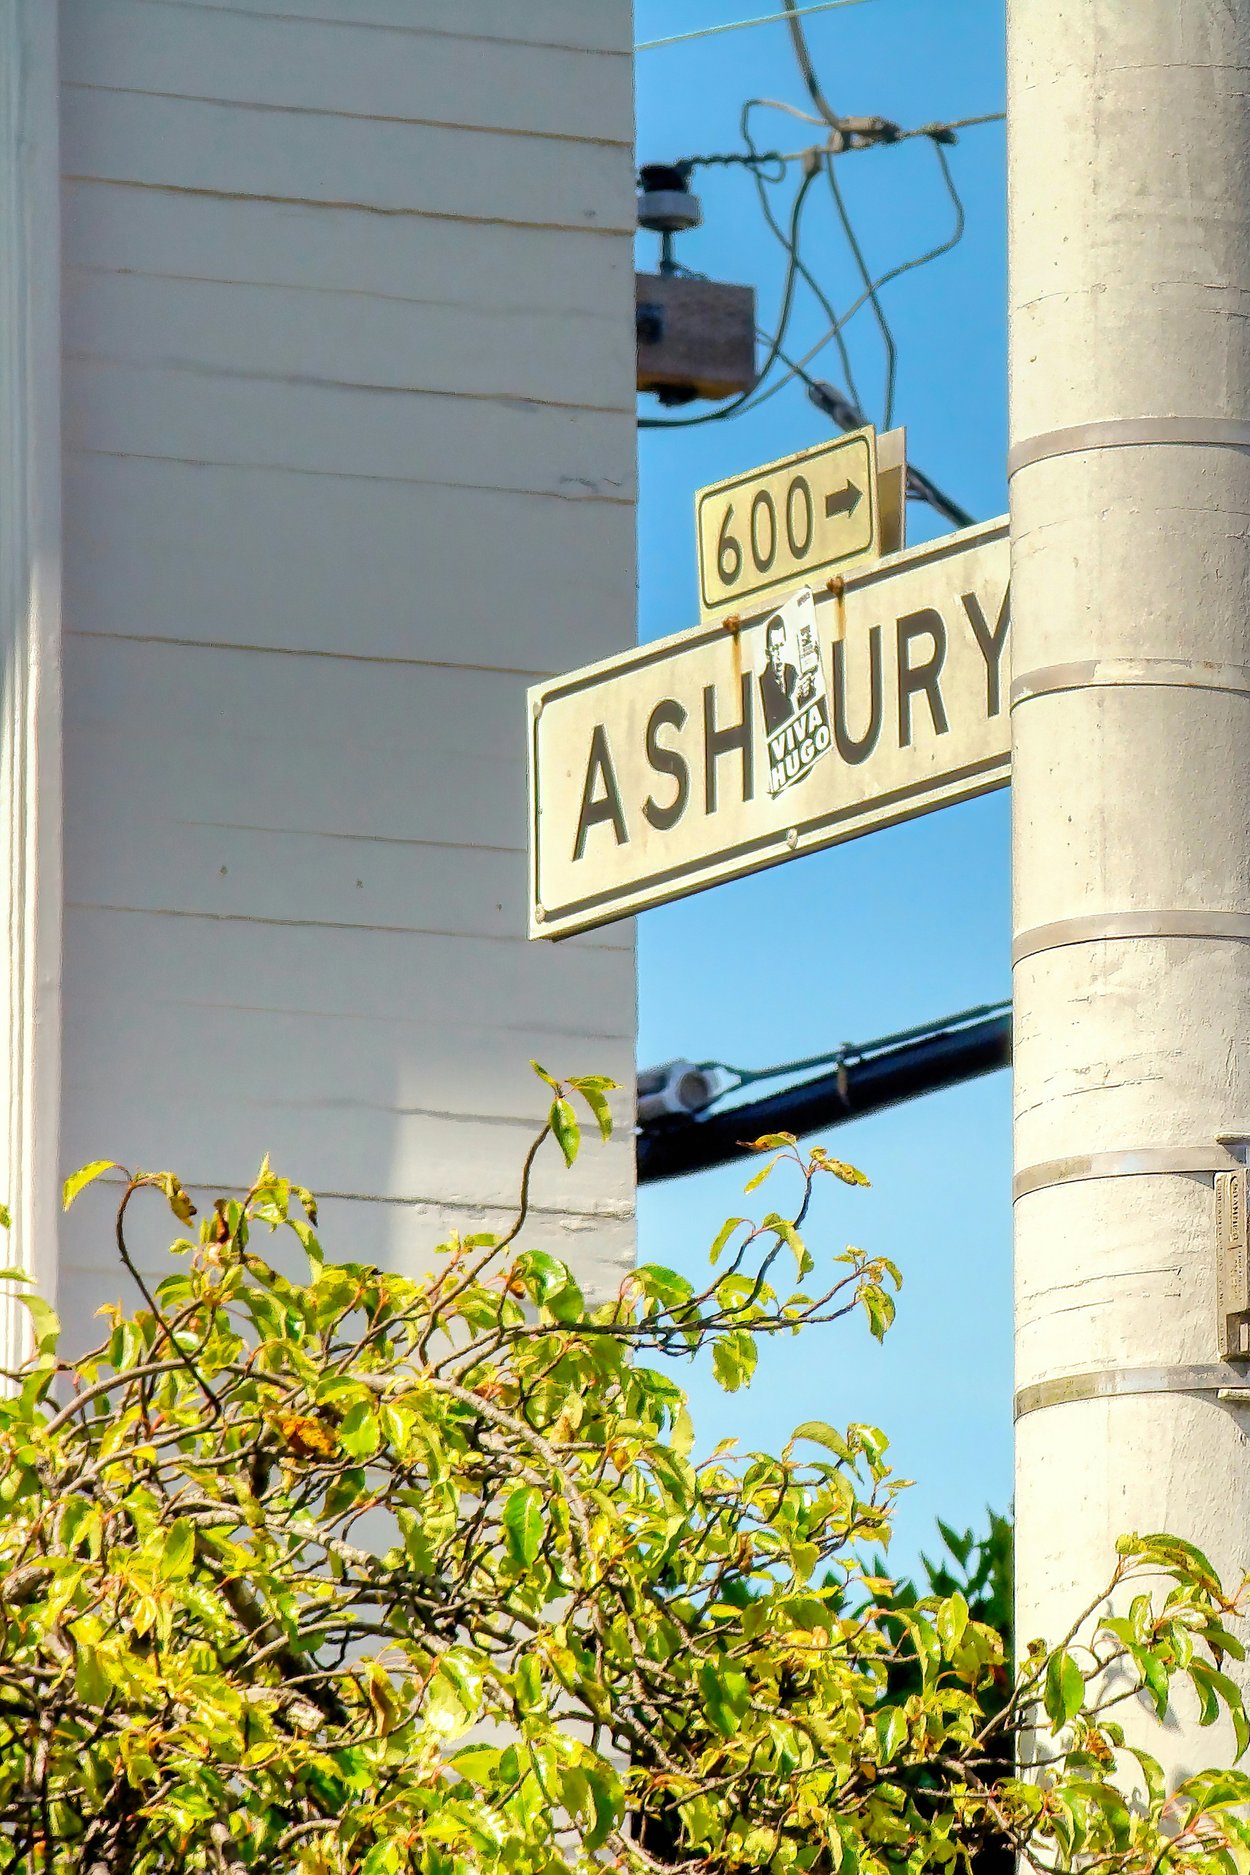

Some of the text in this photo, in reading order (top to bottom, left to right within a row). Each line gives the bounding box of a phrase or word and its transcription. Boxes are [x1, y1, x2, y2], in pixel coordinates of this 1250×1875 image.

[717, 475, 814, 586] 600
[572, 572, 1011, 861] ASHURY
[772, 705, 823, 760] VIVA
[772, 725, 830, 789] HUGO
